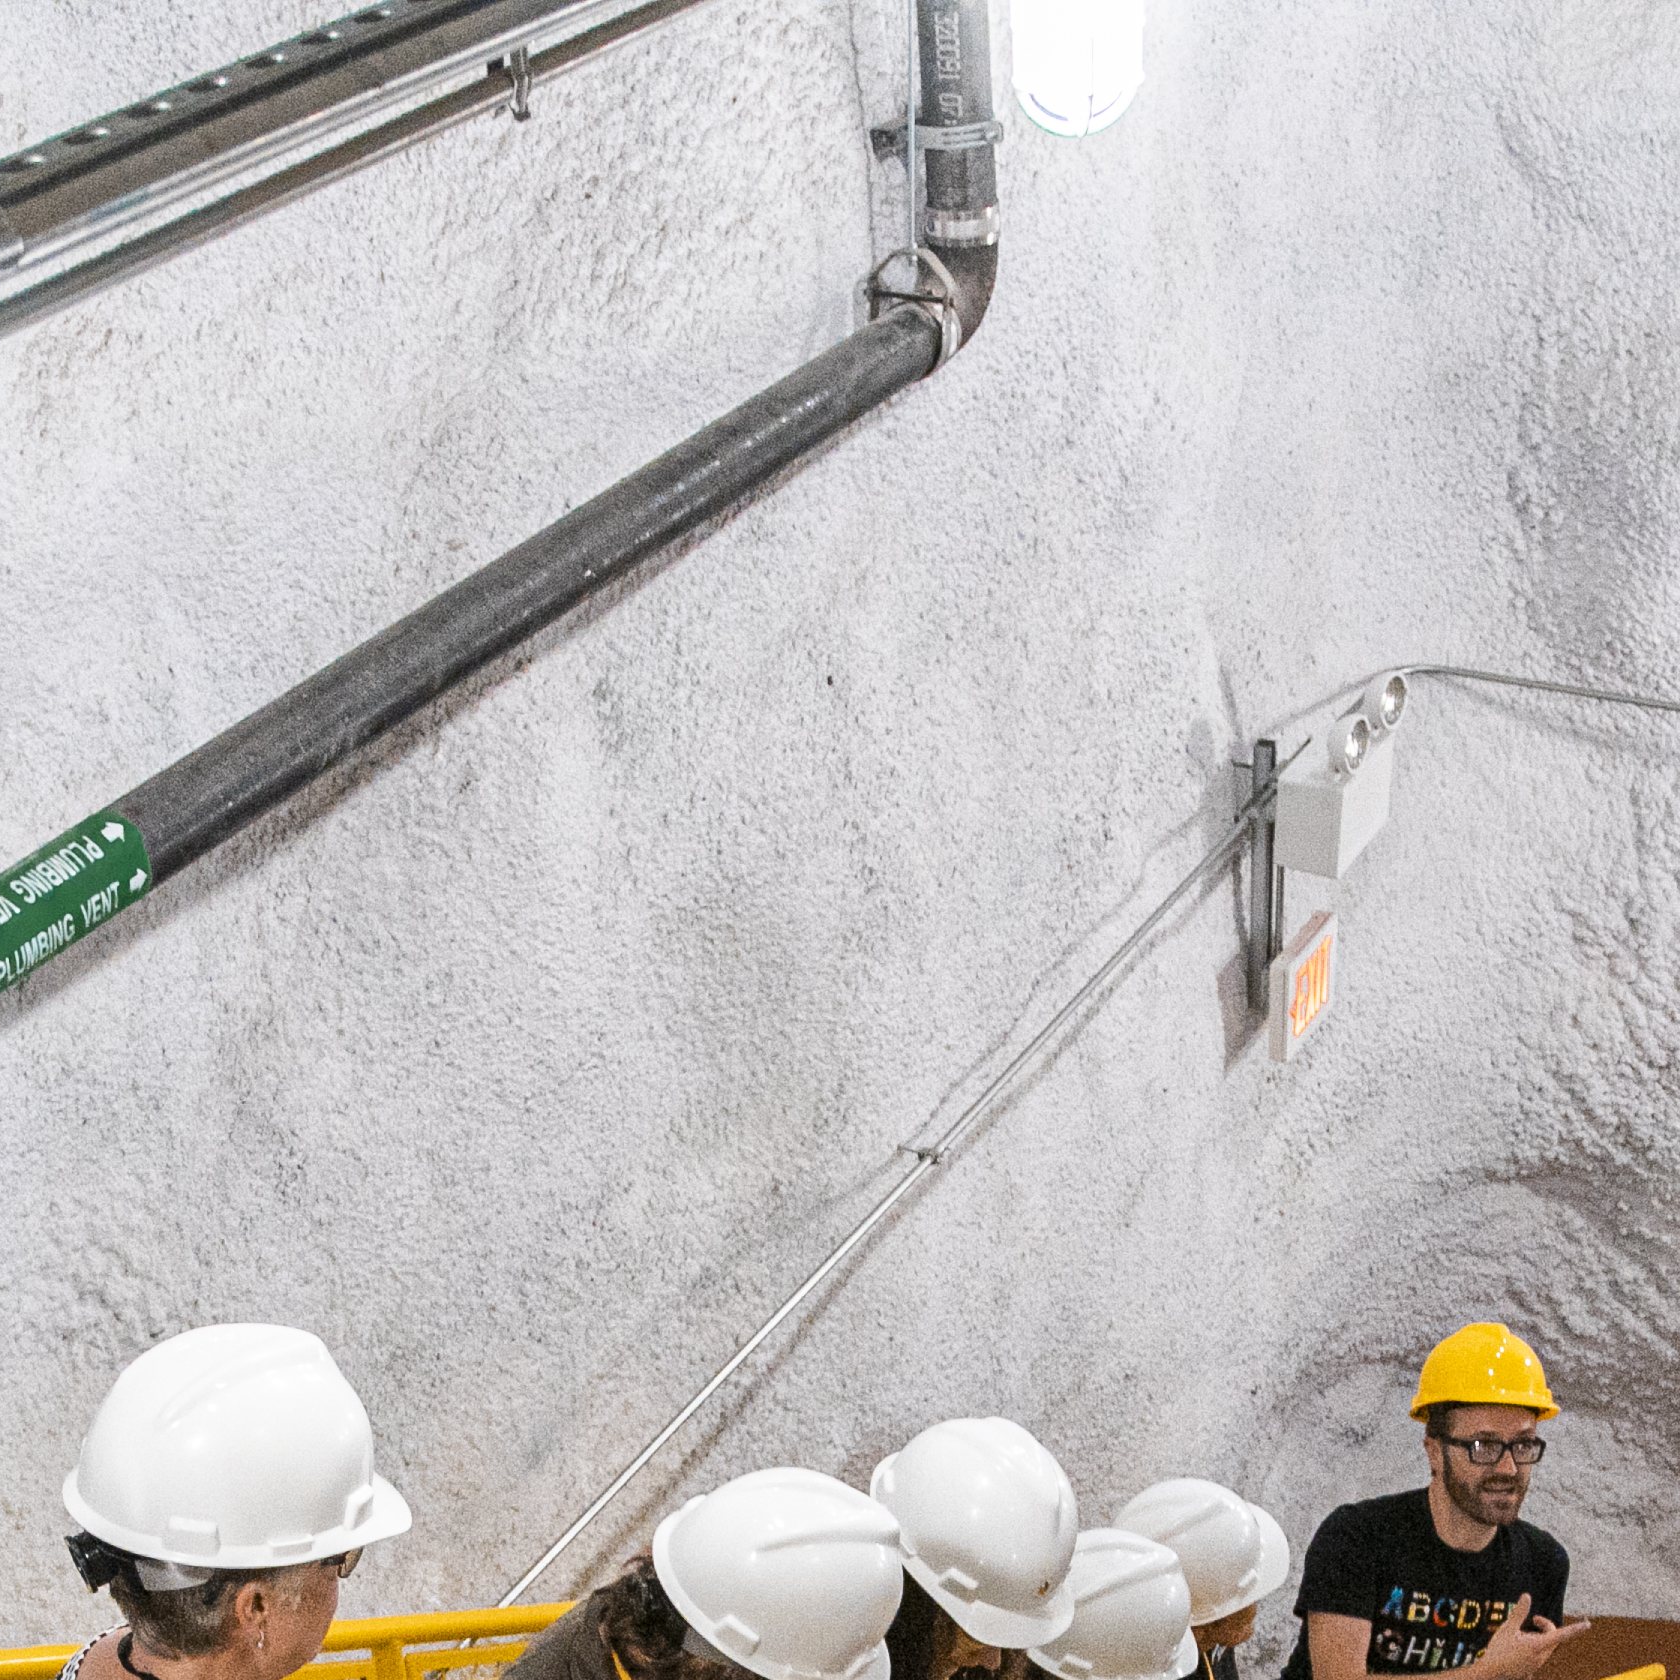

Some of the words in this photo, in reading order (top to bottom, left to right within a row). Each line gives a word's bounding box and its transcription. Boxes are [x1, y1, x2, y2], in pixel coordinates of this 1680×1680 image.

[9, 835, 105, 905] PLUMBING
[81, 881, 121, 928] VENT
[1294, 935, 1332, 1037] EXIT
